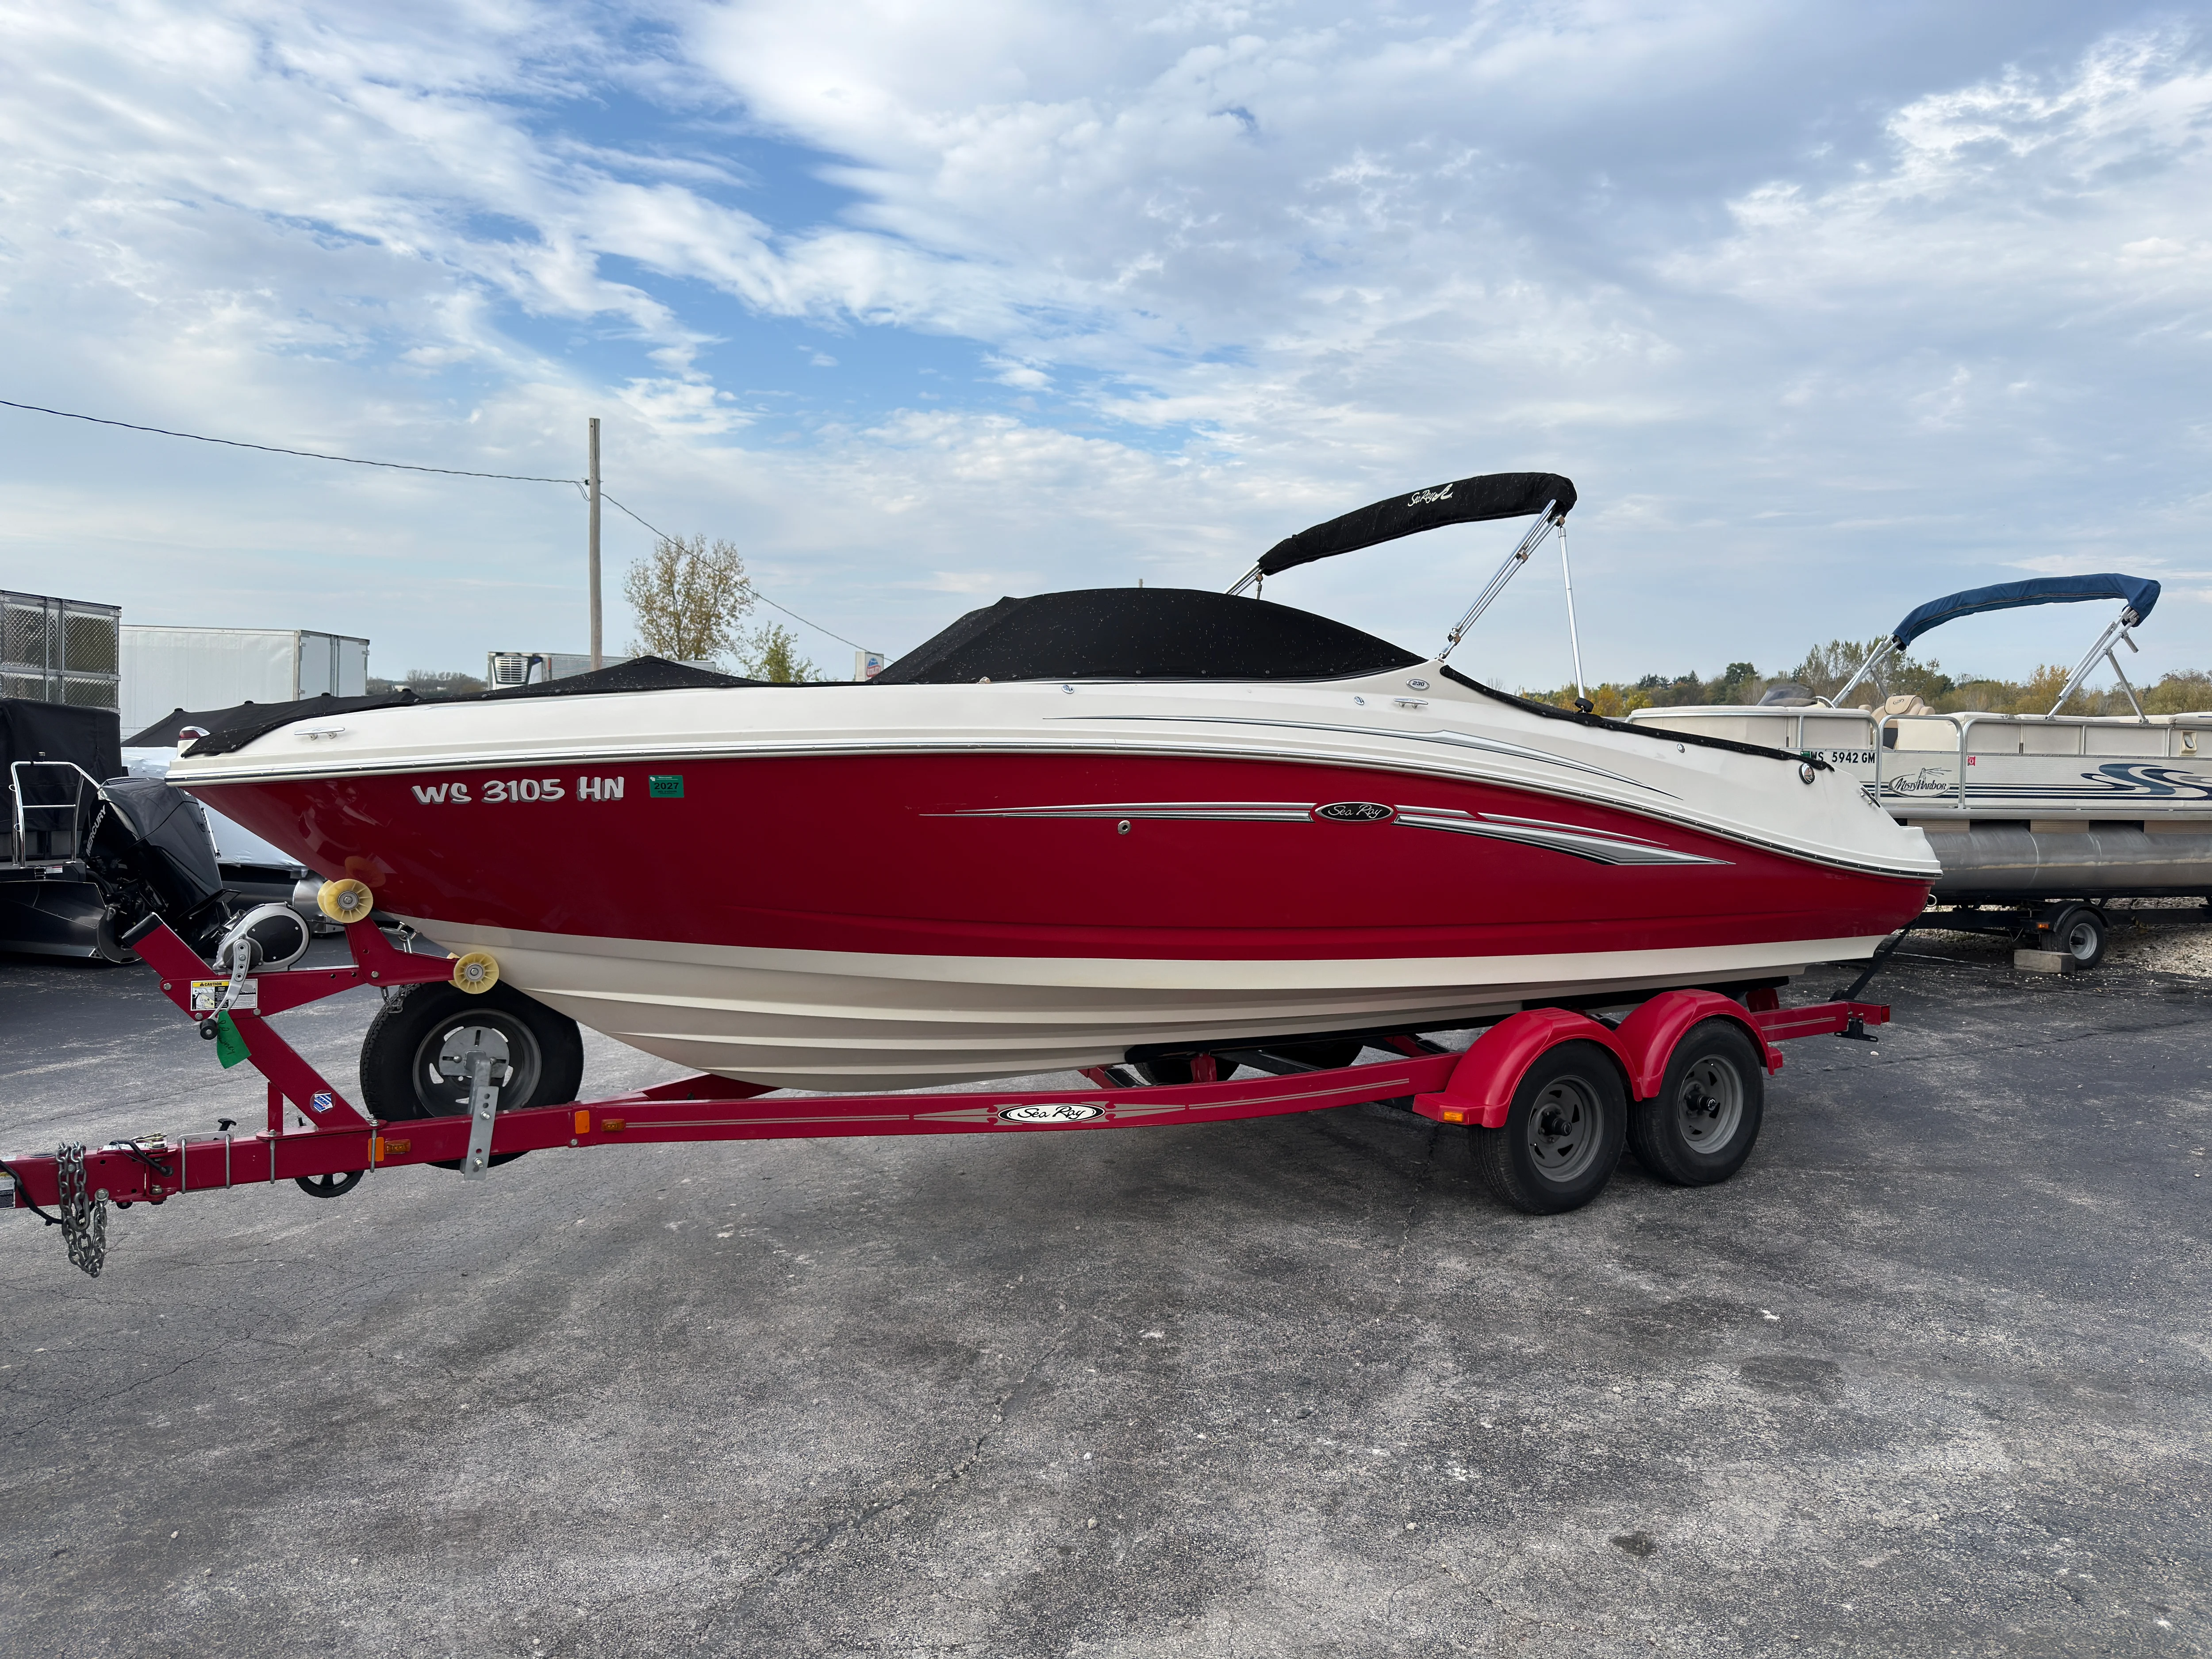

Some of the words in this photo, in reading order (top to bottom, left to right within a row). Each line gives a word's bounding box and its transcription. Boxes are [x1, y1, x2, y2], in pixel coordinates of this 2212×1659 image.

[1407, 492, 1421, 507] Sea
[1419, 489, 1436, 503] Ray
[1811, 752, 1824, 761] WS
[1832, 752, 1858, 763] 5942
[1862, 753, 1875, 763] GM
[411, 783, 472, 805] WS
[481, 779, 565, 803] 3105
[576, 776, 624, 802] HN
[1328, 805, 1354, 816] Sea
[1356, 804, 1383, 818] Ray
[86, 804, 106, 857] MERCURY
[1018, 1108, 1051, 1118] Sea
[1052, 1106, 1086, 1119] Ray
